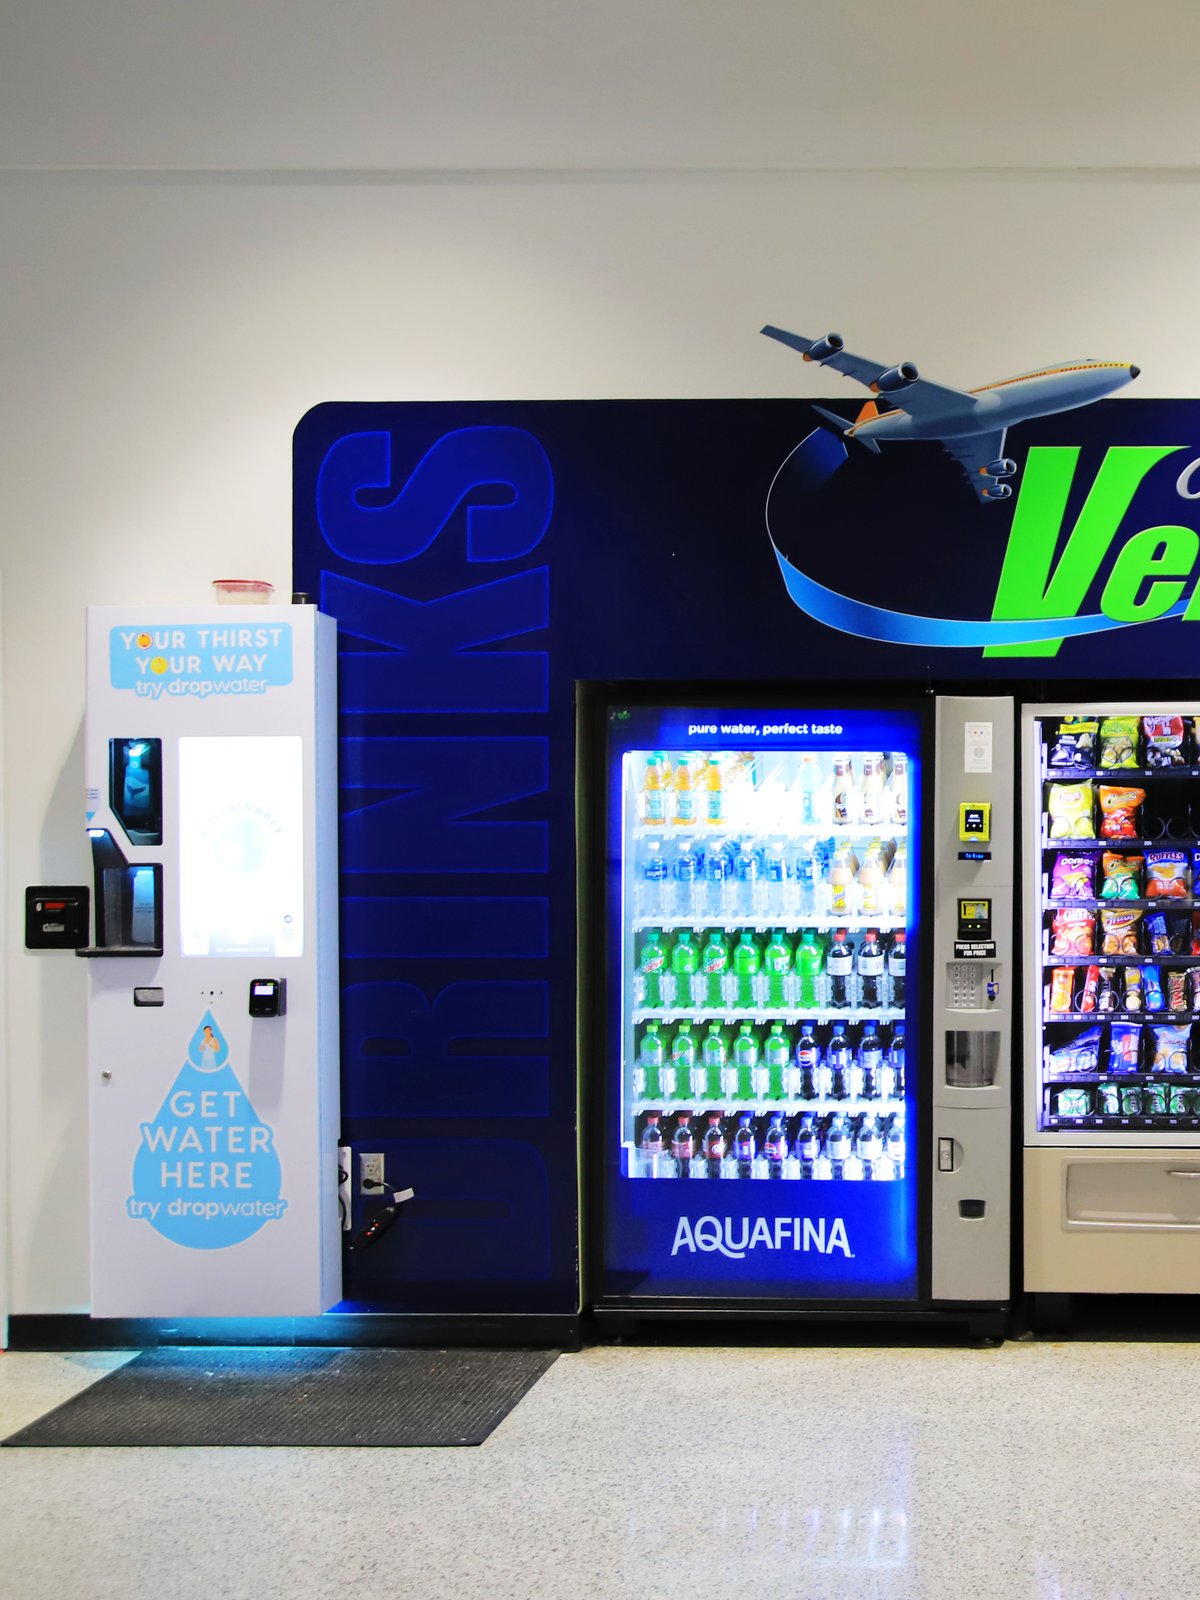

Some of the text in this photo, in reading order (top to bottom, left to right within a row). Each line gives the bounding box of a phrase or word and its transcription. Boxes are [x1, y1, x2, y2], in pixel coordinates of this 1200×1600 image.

[120, 629, 283, 650] YOUR THIRST
[136, 653, 268, 675] YOUR WAY
[136, 678, 267, 698] try dropwater
[688, 723, 843, 736] pure water, perfect taste
[316, 425, 554, 1282] DRINKS
[1149, 852, 1184, 861] RUFFLES
[170, 1090, 241, 1118] GET
[143, 1126, 271, 1153] WATER
[161, 1162, 252, 1188] HERE
[129, 1198, 287, 1220] try dropwater
[671, 1215, 855, 1259] AQUAFINA
